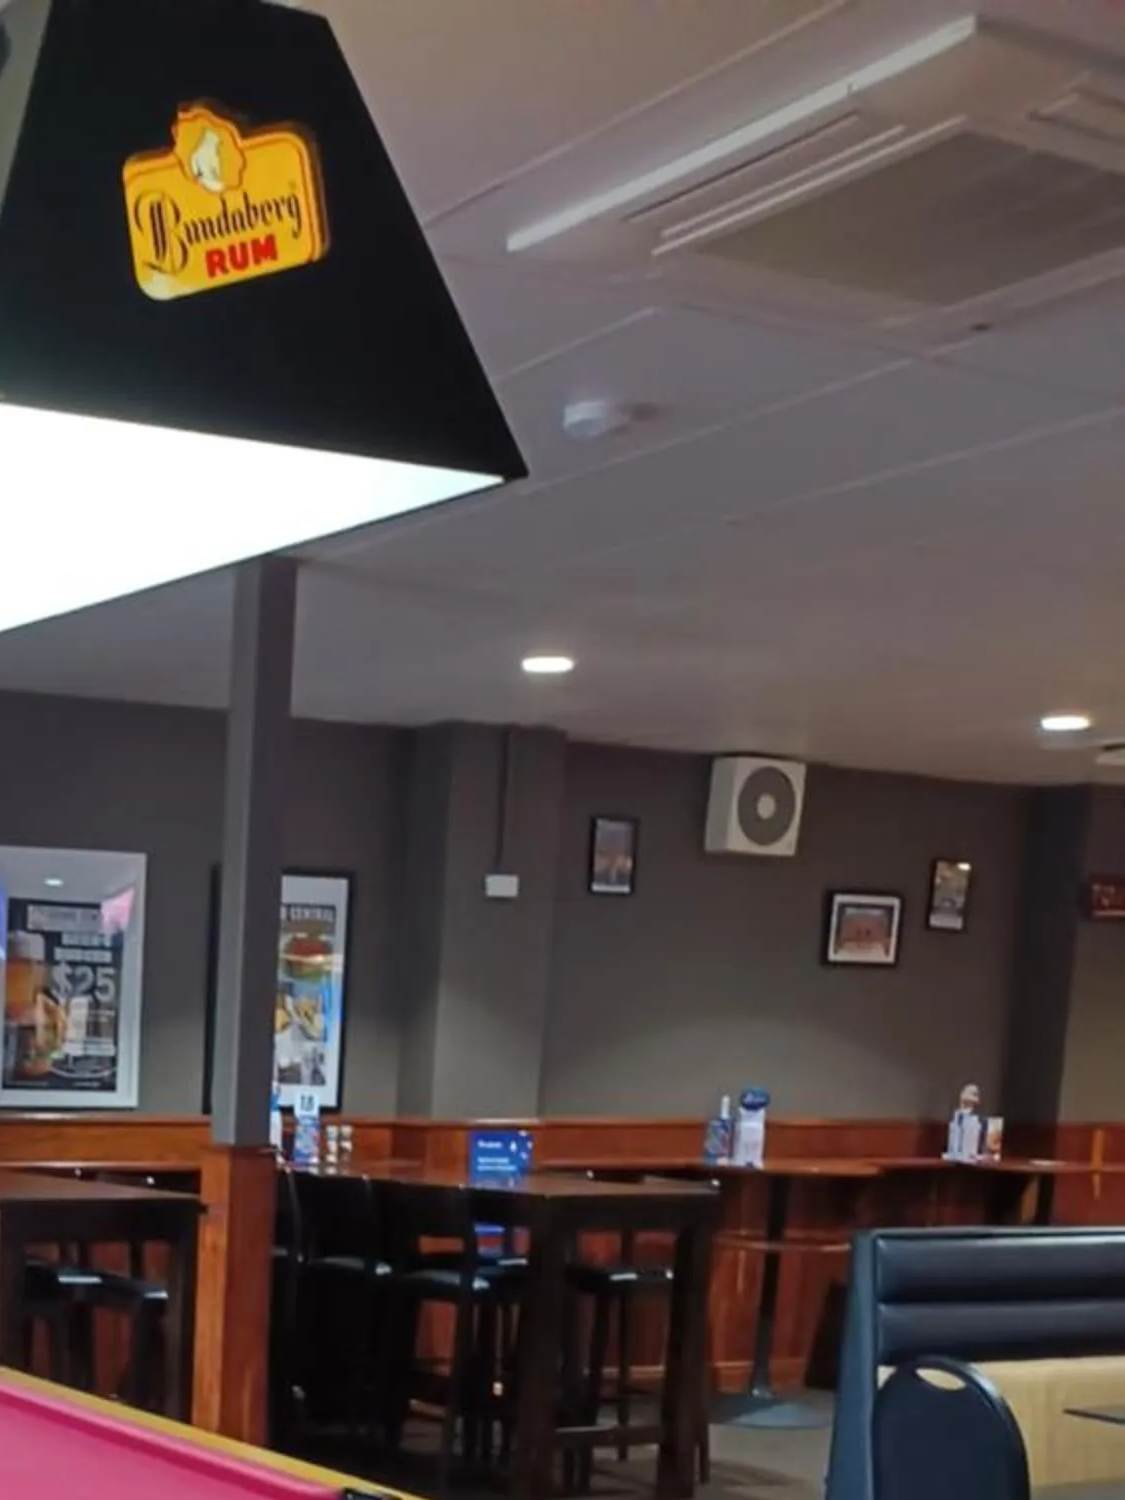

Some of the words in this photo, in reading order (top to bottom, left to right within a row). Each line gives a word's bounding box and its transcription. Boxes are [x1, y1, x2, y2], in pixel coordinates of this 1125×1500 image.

[133, 189, 303, 276] Bundaberg
[205, 234, 278, 279] RUM
[52, 961, 116, 1003] $25
